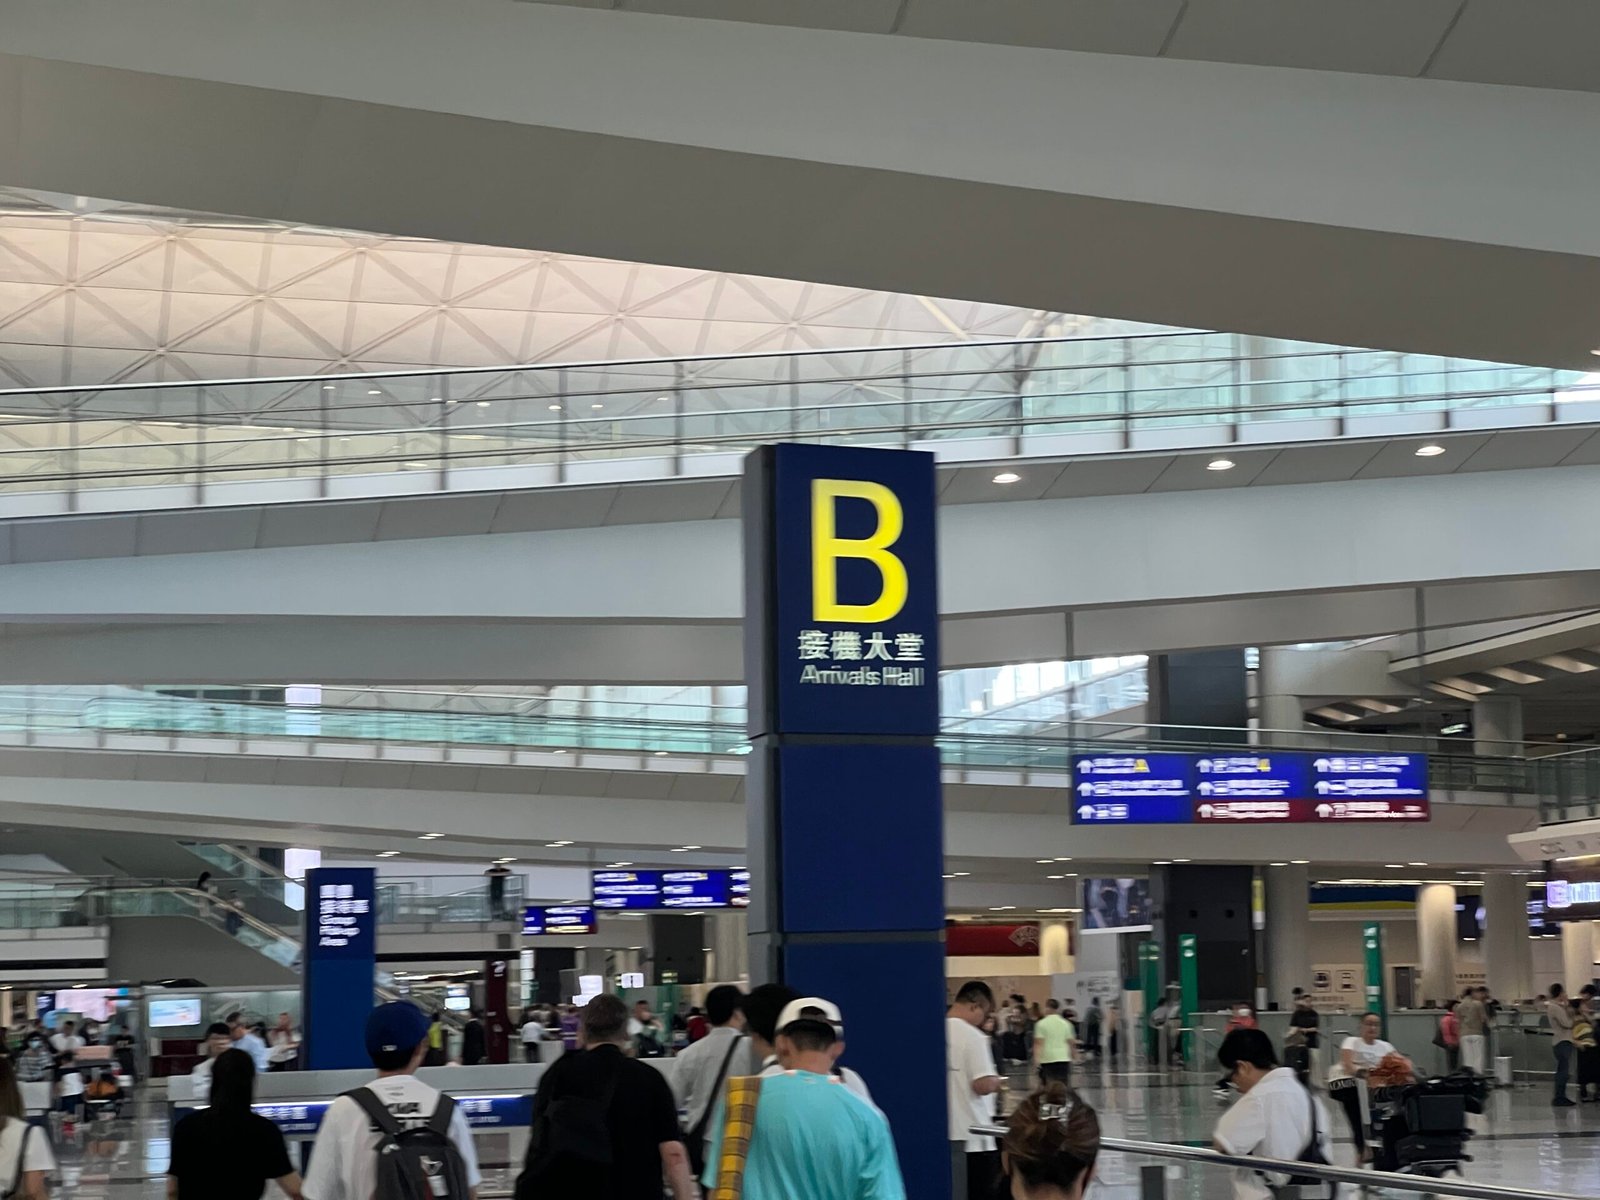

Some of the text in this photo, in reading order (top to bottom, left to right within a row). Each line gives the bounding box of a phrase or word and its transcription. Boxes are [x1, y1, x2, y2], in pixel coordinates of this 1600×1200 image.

[811, 478, 909, 623] B
[798, 629, 926, 661] 接機大堂
[800, 664, 925, 686] Arrivals Hall
